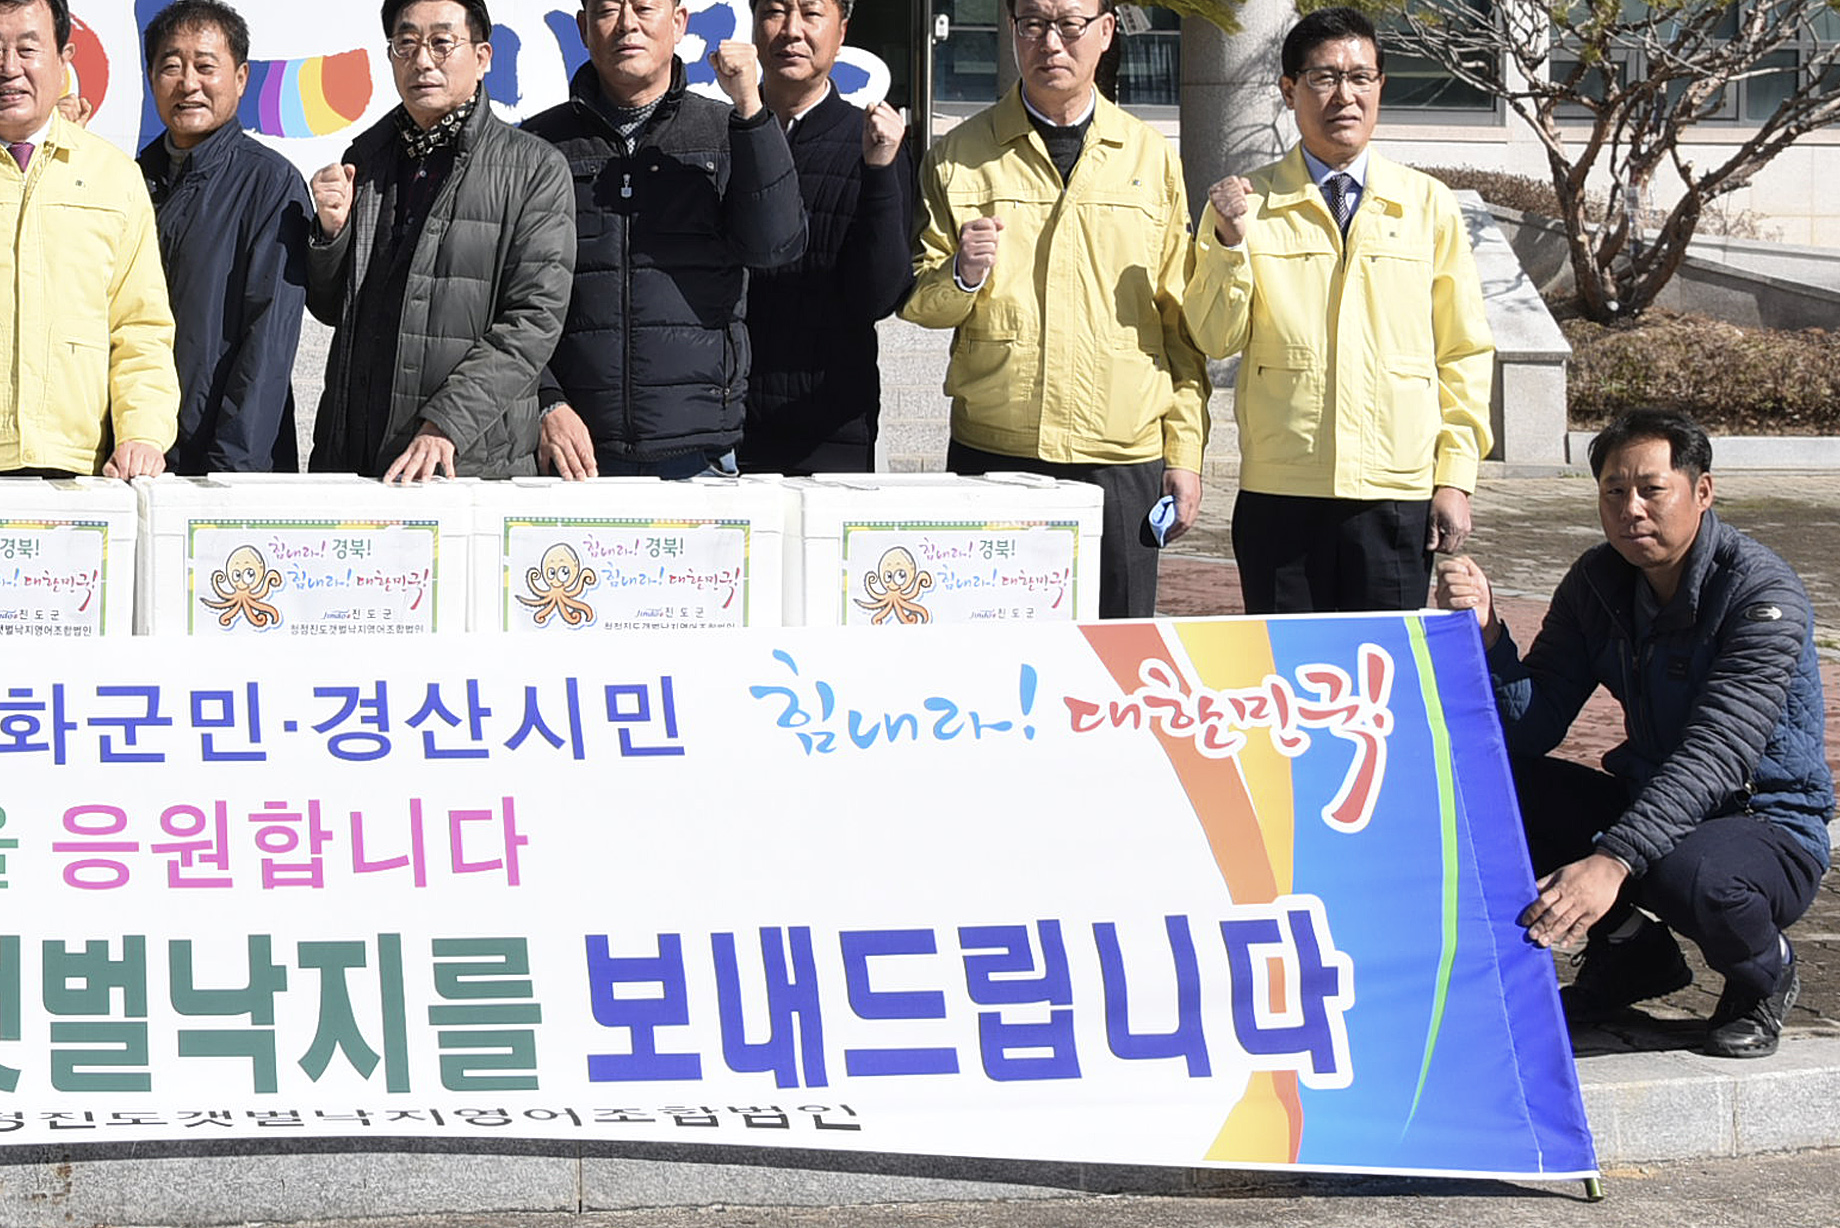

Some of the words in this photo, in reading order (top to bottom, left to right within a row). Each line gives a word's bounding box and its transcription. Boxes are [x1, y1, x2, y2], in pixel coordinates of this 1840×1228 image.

[0, 538, 40, 559] 경북!
[332, 539, 371, 560] 경북!
[645, 537, 684, 558] 경북!
[979, 539, 1016, 560] 경북!
[749, 649, 1038, 755] 힘내라!
[1063, 652, 1385, 824] 대한민국!
[52, 796, 529, 890] 응원합니다
[585, 910, 1339, 1089] 보내드립니다
